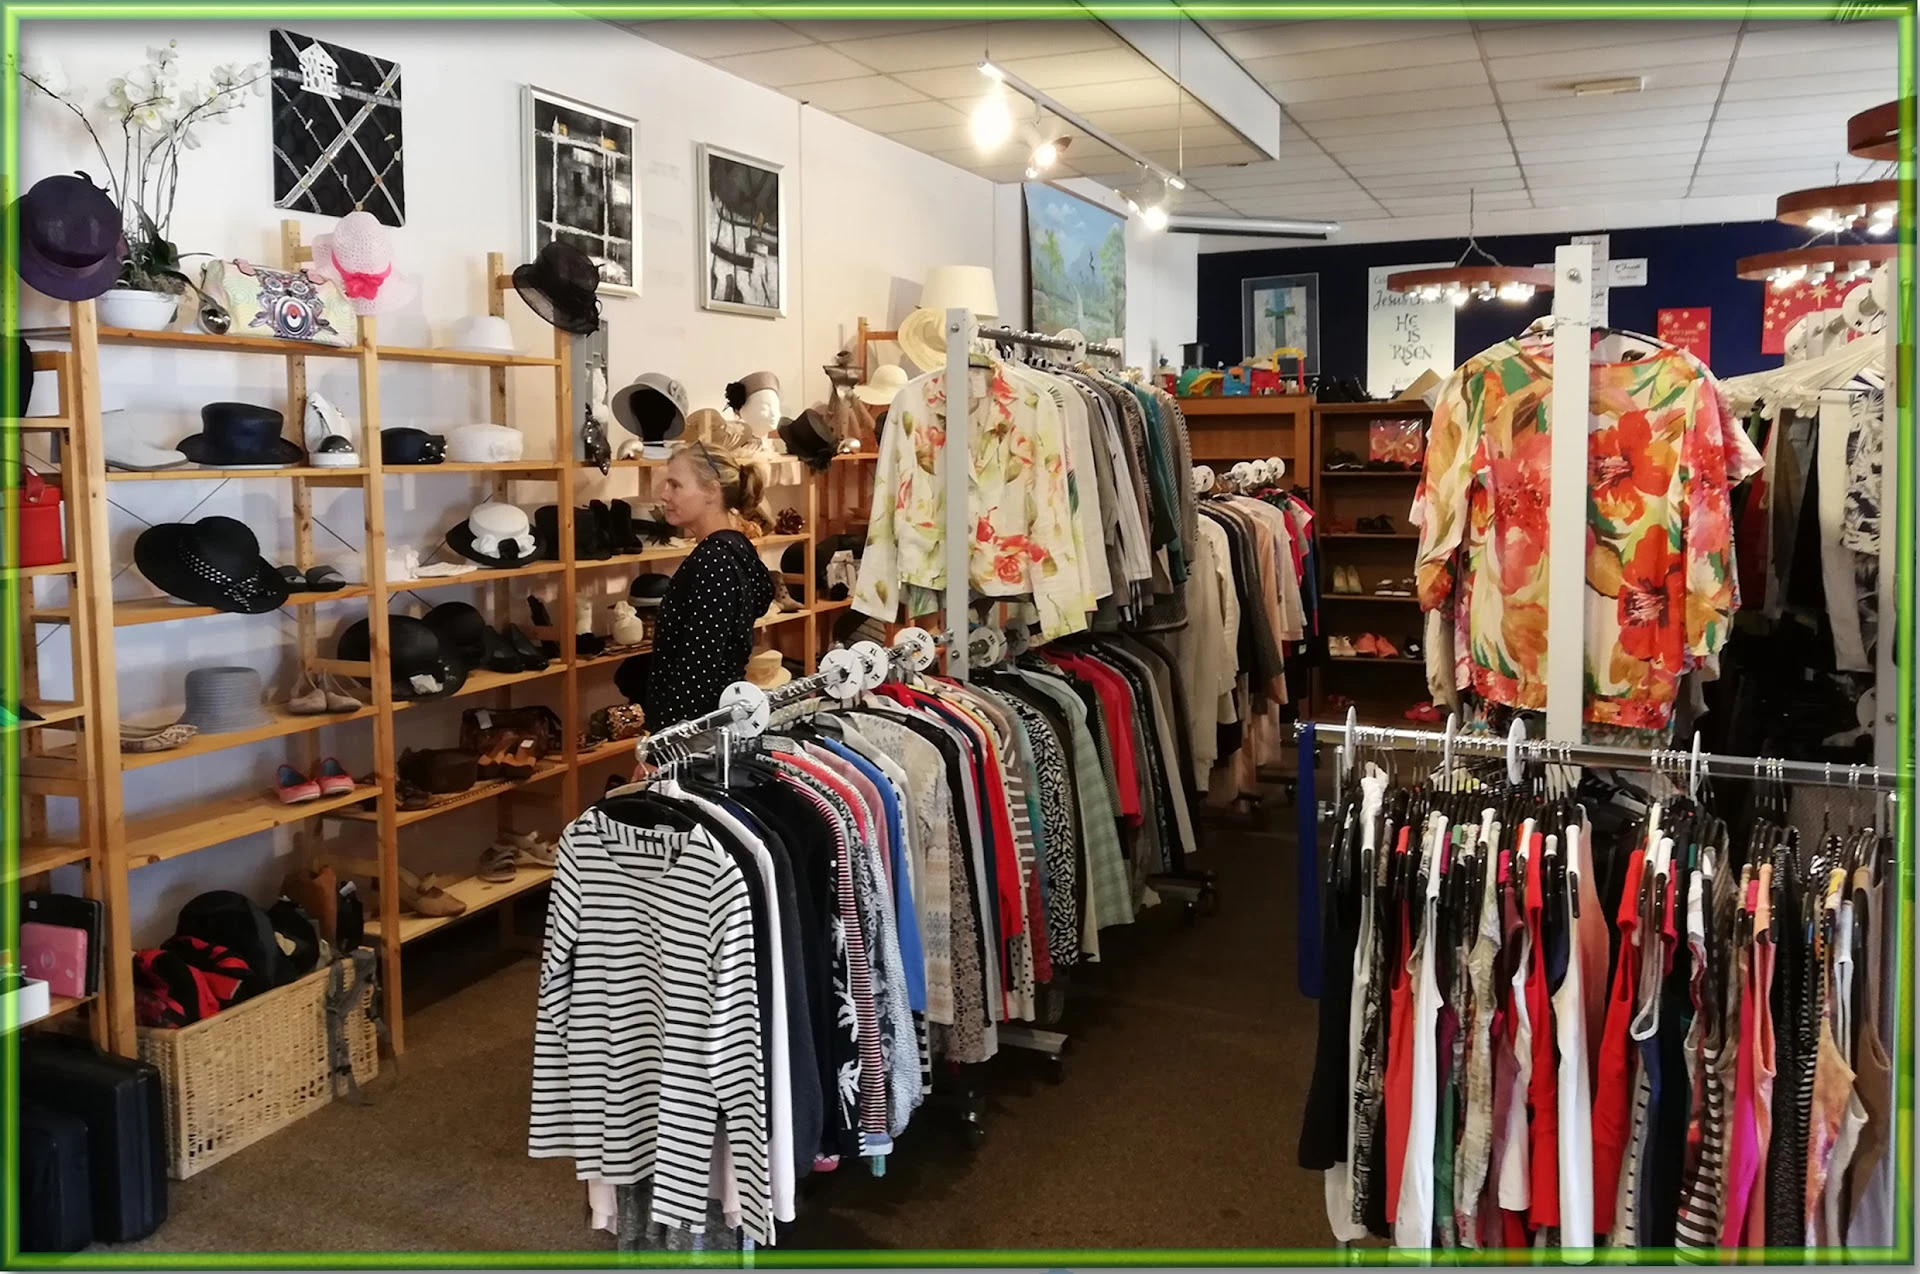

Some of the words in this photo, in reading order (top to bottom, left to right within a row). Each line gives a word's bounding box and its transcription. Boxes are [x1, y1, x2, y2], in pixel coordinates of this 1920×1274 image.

[1373, 290, 1410, 311] Jesus
[1407, 328, 1421, 343] IS
[1389, 344, 1434, 366] RISEN
